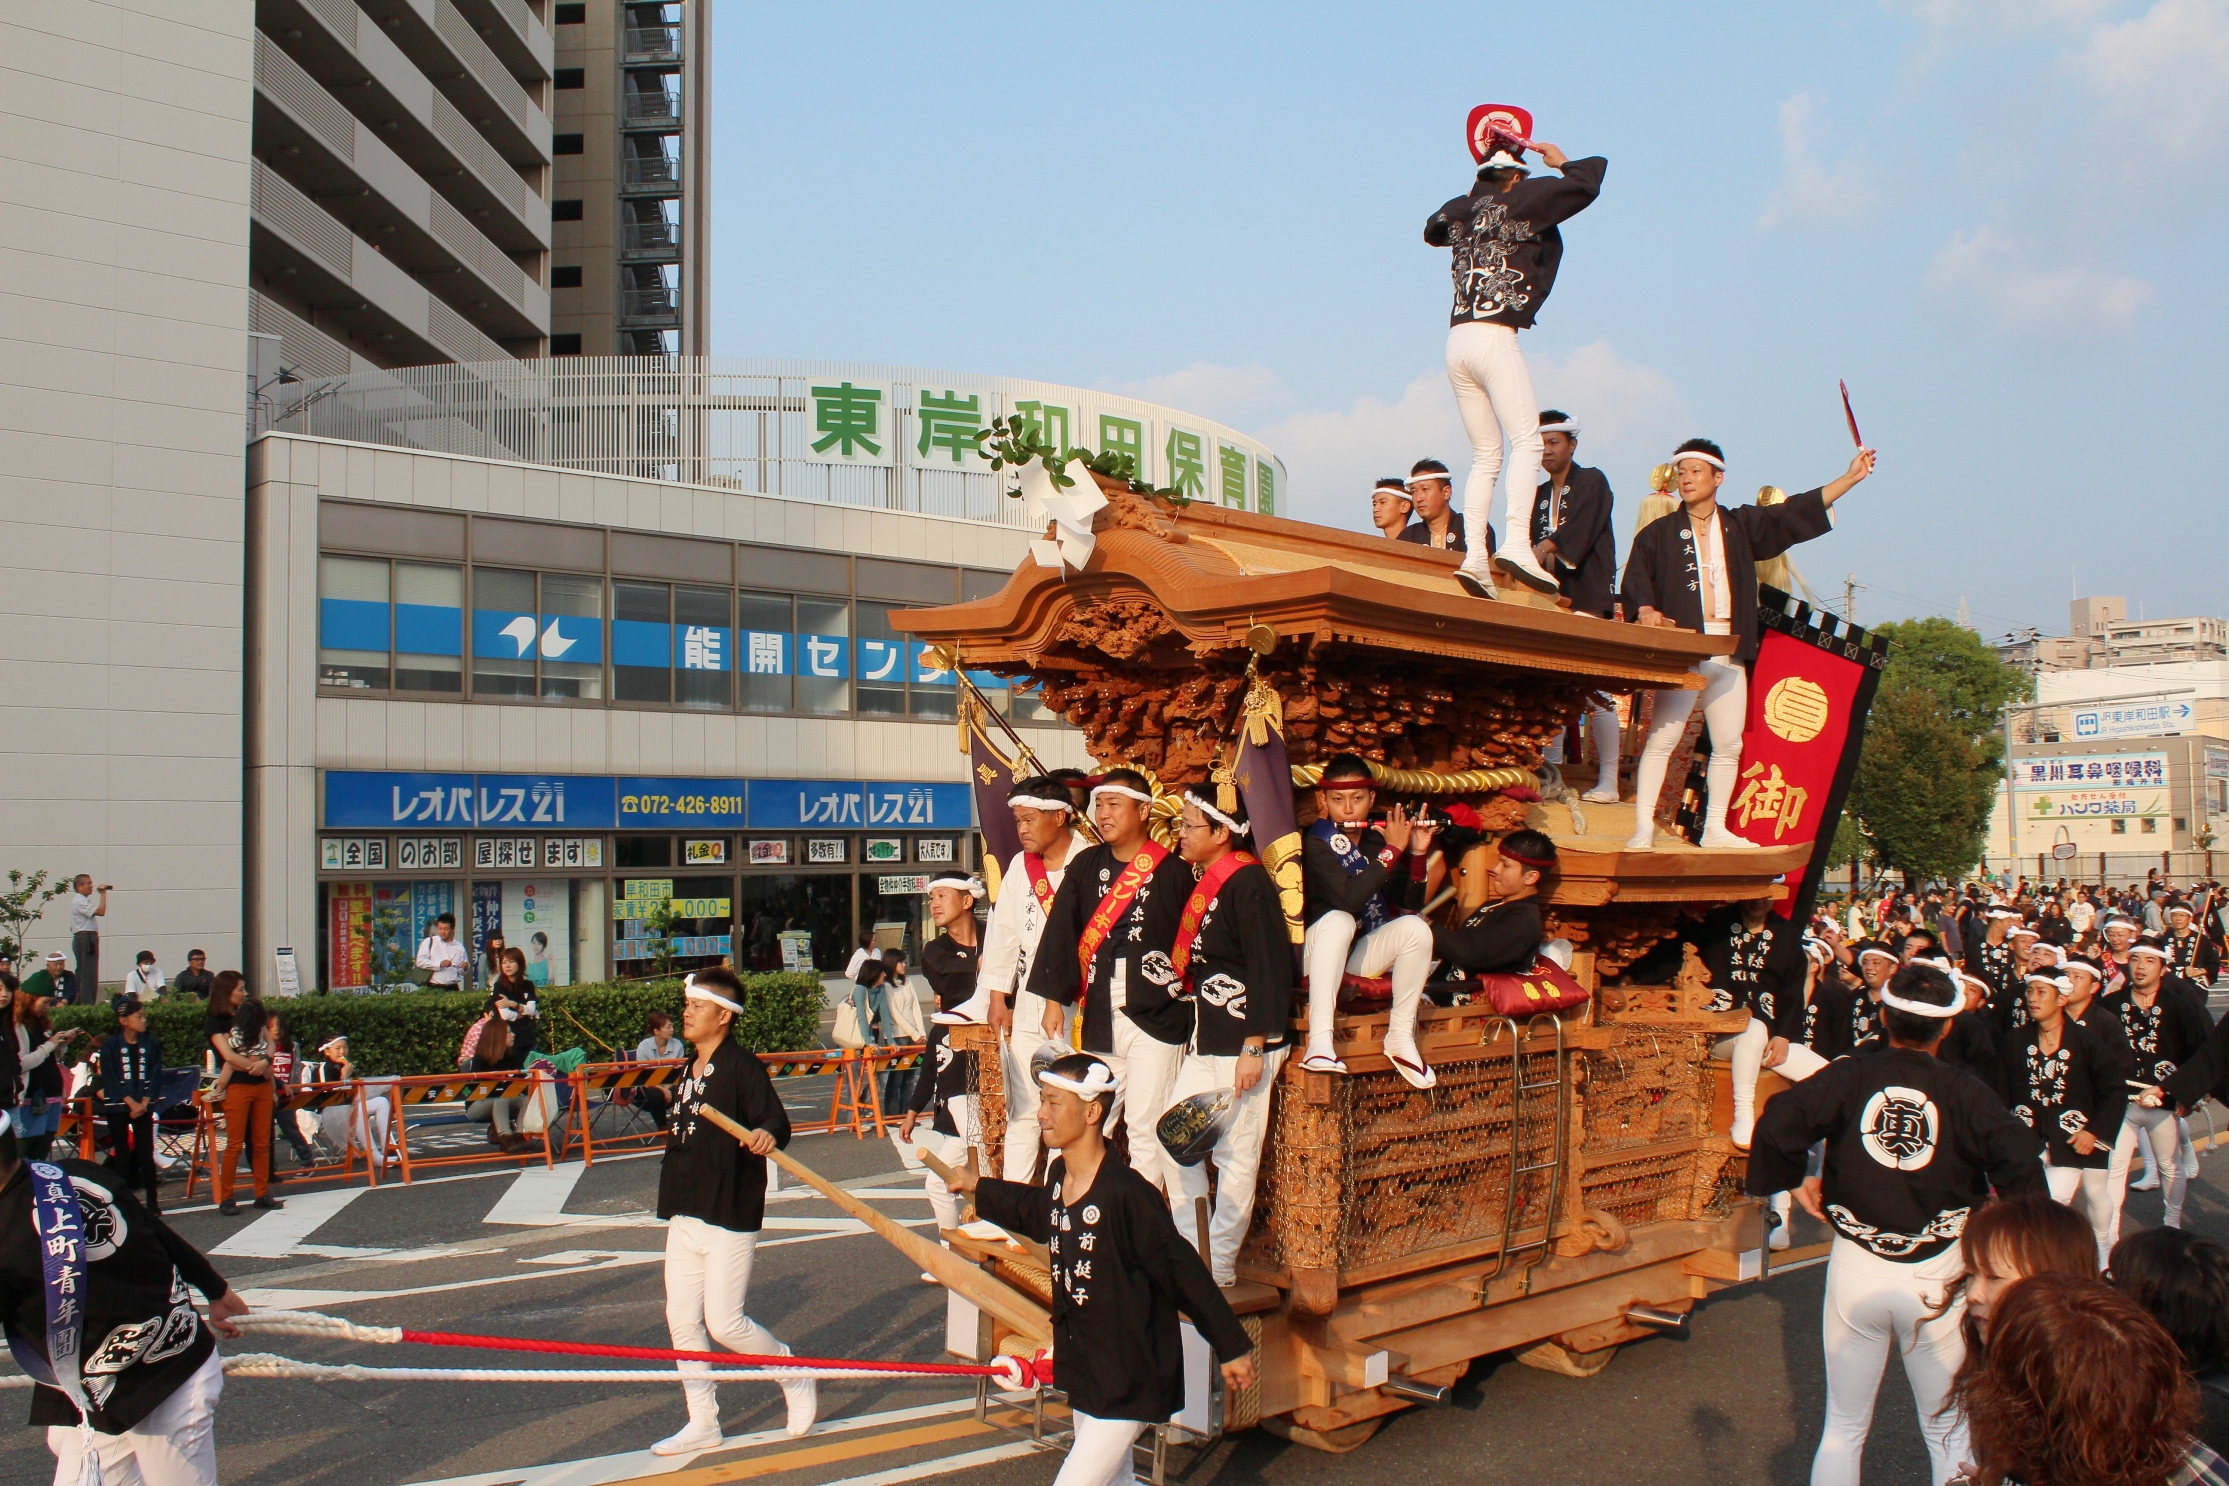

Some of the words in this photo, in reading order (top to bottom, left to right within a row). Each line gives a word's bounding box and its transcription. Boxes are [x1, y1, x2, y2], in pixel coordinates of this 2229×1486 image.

[811, 381, 1274, 516] 東岸和田保育園
[392, 782, 565, 822] レオパレス21
[640, 795, 742, 814] 072-426-8911
[799, 787, 934, 823] レオパレス21
[1731, 761, 1808, 840] 御
[2059, 800, 2136, 816] ハンワ薬局
[626, 881, 672, 898] 岸和田市
[42, 1182, 82, 1361] 真上町青年團
